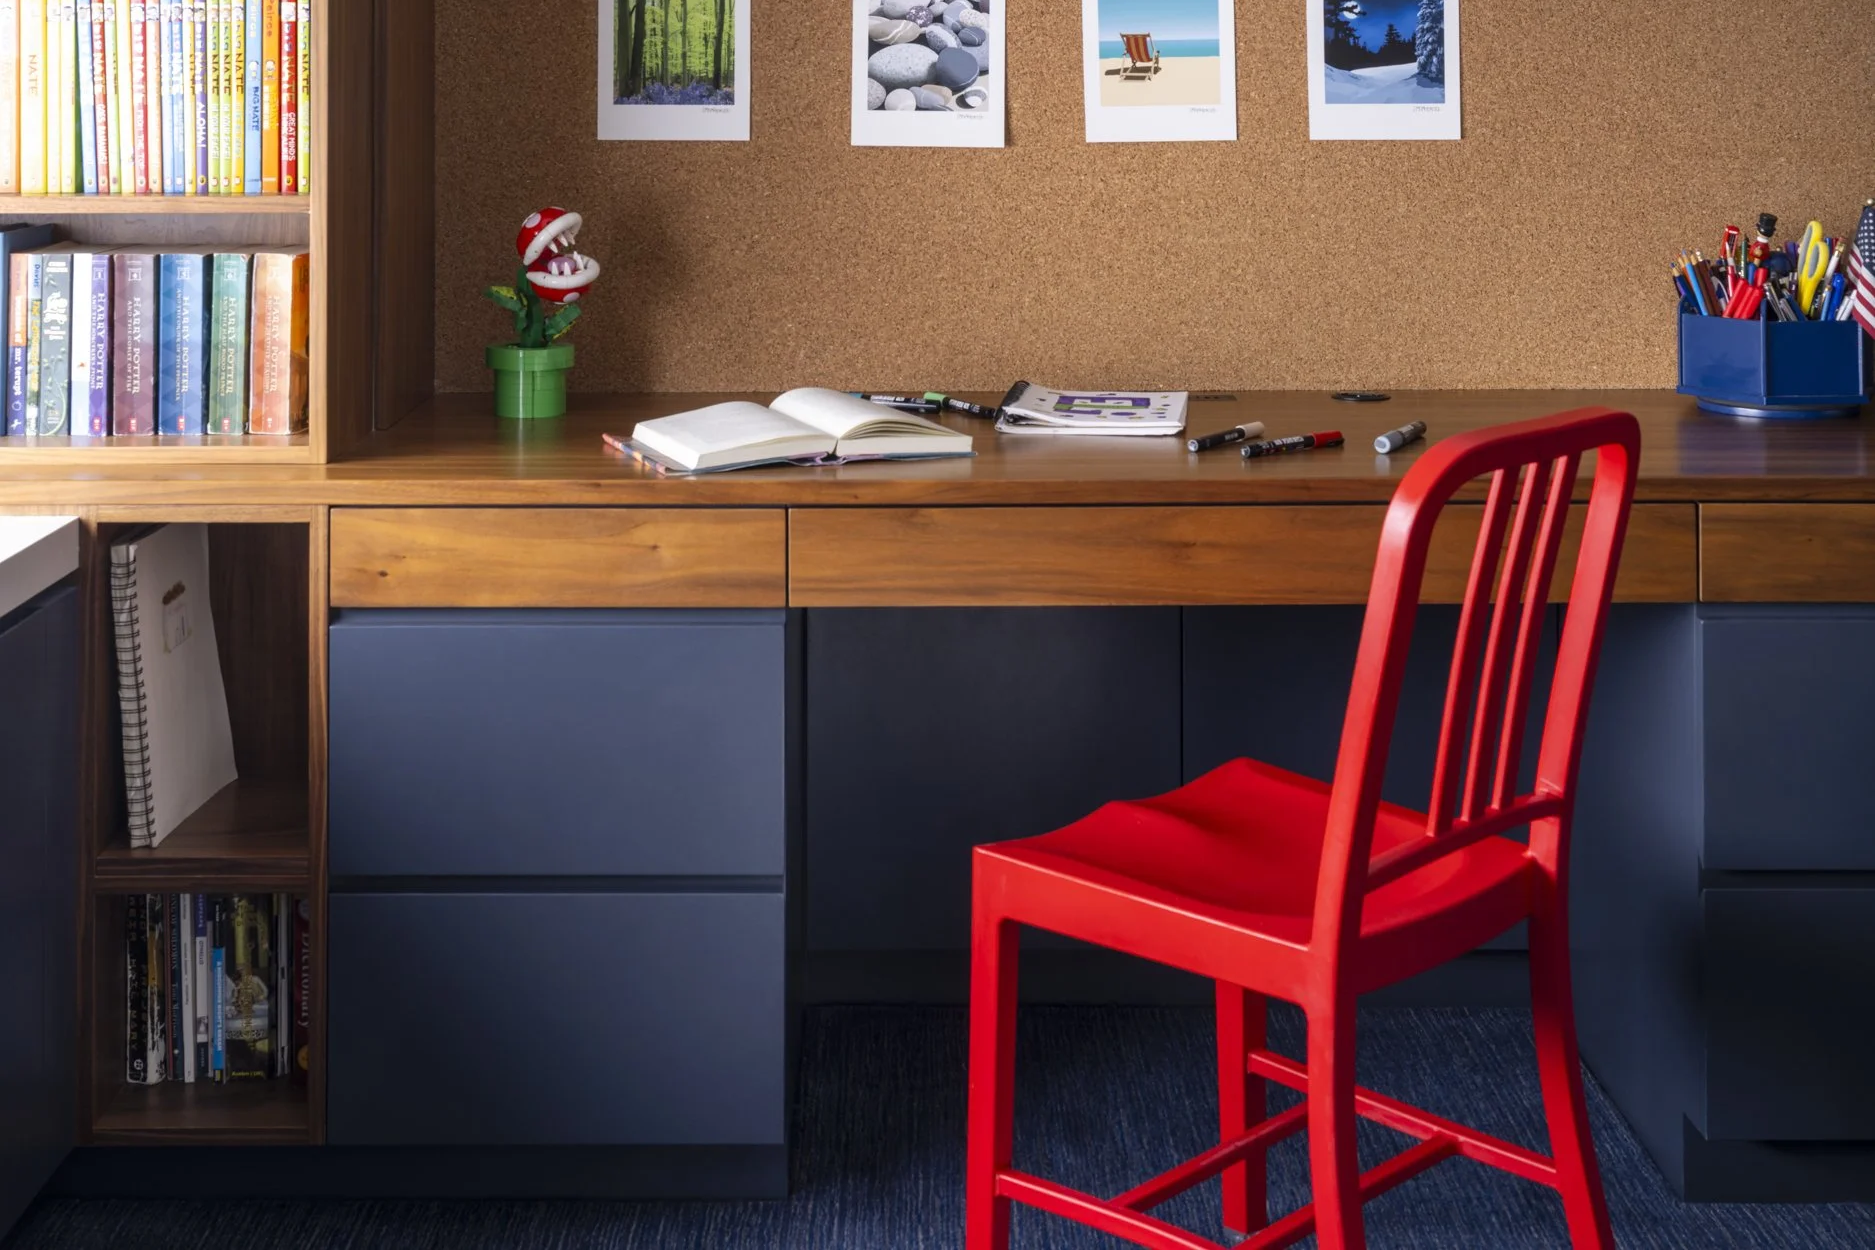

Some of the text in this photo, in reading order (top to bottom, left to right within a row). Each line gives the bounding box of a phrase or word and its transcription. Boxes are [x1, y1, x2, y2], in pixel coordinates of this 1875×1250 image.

[28, 54, 38, 97] NATE
[196, 102, 206, 148] ALOHA!
[96, 292, 105, 390] HARRY POTTER
[182, 296, 190, 342] HARRY
[14, 348, 22, 364] mr.
[132, 297, 142, 394] HARRY POTTER
[226, 297, 236, 394] HARRY POTTER
[270, 296, 280, 392] HARRY POTTER
[13, 366, 22, 396] terupt
[130, 1010, 138, 1050] MARY
